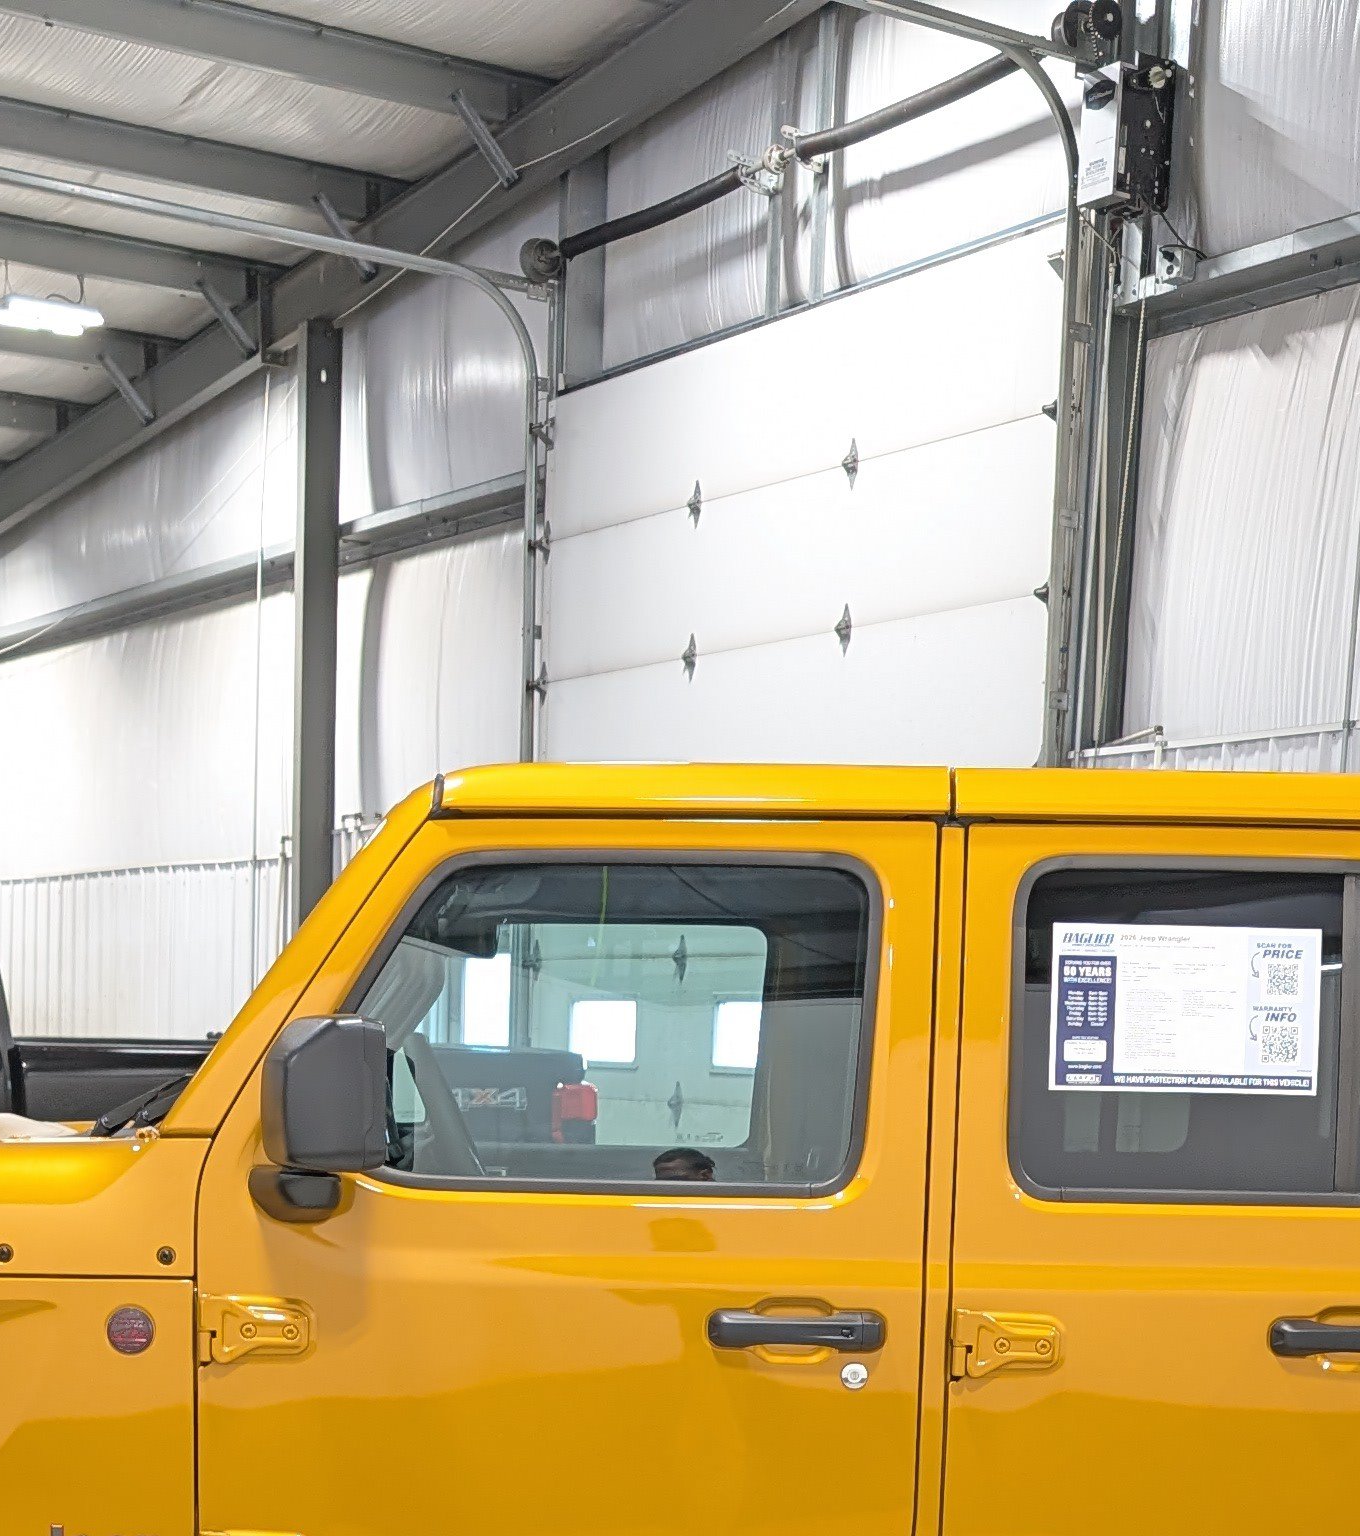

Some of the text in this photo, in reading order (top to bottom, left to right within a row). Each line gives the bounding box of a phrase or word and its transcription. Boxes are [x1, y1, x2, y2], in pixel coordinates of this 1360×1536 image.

[1158, 935, 1191, 943] Wrangler
[1262, 949, 1303, 959] PRICE
[1078, 966, 1112, 977] YEARS
[1264, 1012, 1297, 1022] INFO
[1145, 1076, 1187, 1084] PROTECTION
[1188, 1077, 1211, 1085] PLANS
[1211, 1077, 1248, 1085] AVAILABLE
[1248, 1078, 1262, 1086] FOR
